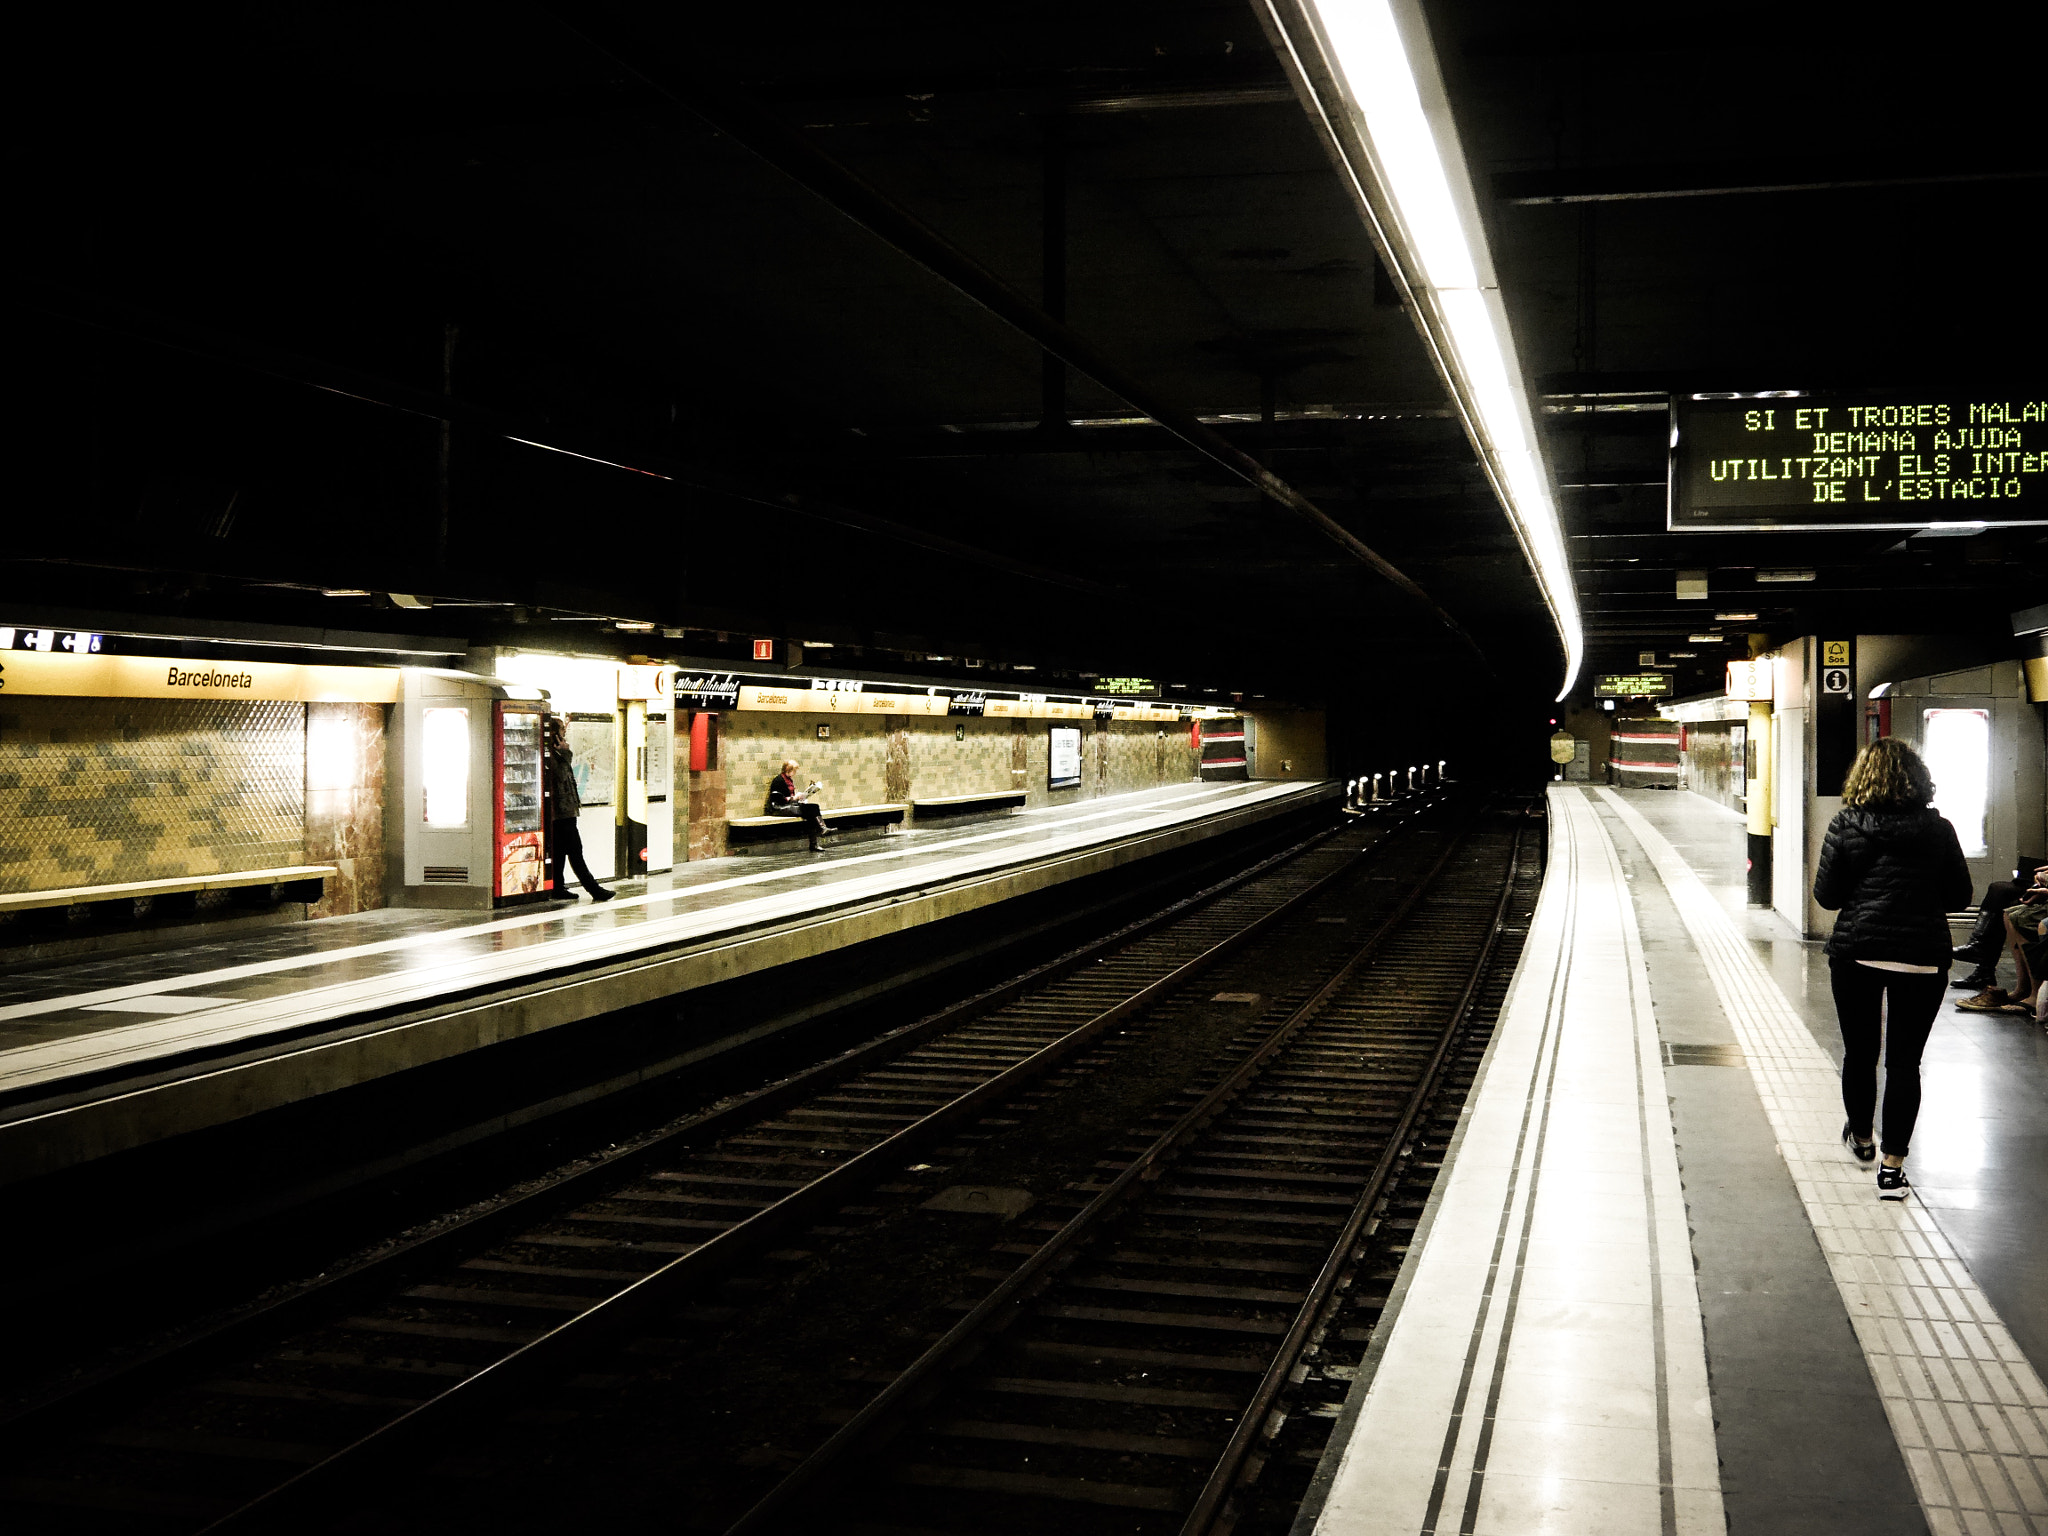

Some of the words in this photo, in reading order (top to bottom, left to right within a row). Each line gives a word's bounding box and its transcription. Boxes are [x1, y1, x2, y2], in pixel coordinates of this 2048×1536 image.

[1744, 409, 1775, 431] SI
[1795, 407, 1830, 430] ET
[1847, 404, 1951, 428] TROBES
[1812, 429, 1916, 454] DEMANA
[1934, 426, 2022, 451] AJUDA
[1710, 455, 1881, 482] UTILITZANT
[1898, 453, 1951, 477] ELS
[1812, 480, 1847, 503] DE
[1828, 656, 1845, 664] Sos
[167, 666, 252, 689] Barceloneta
